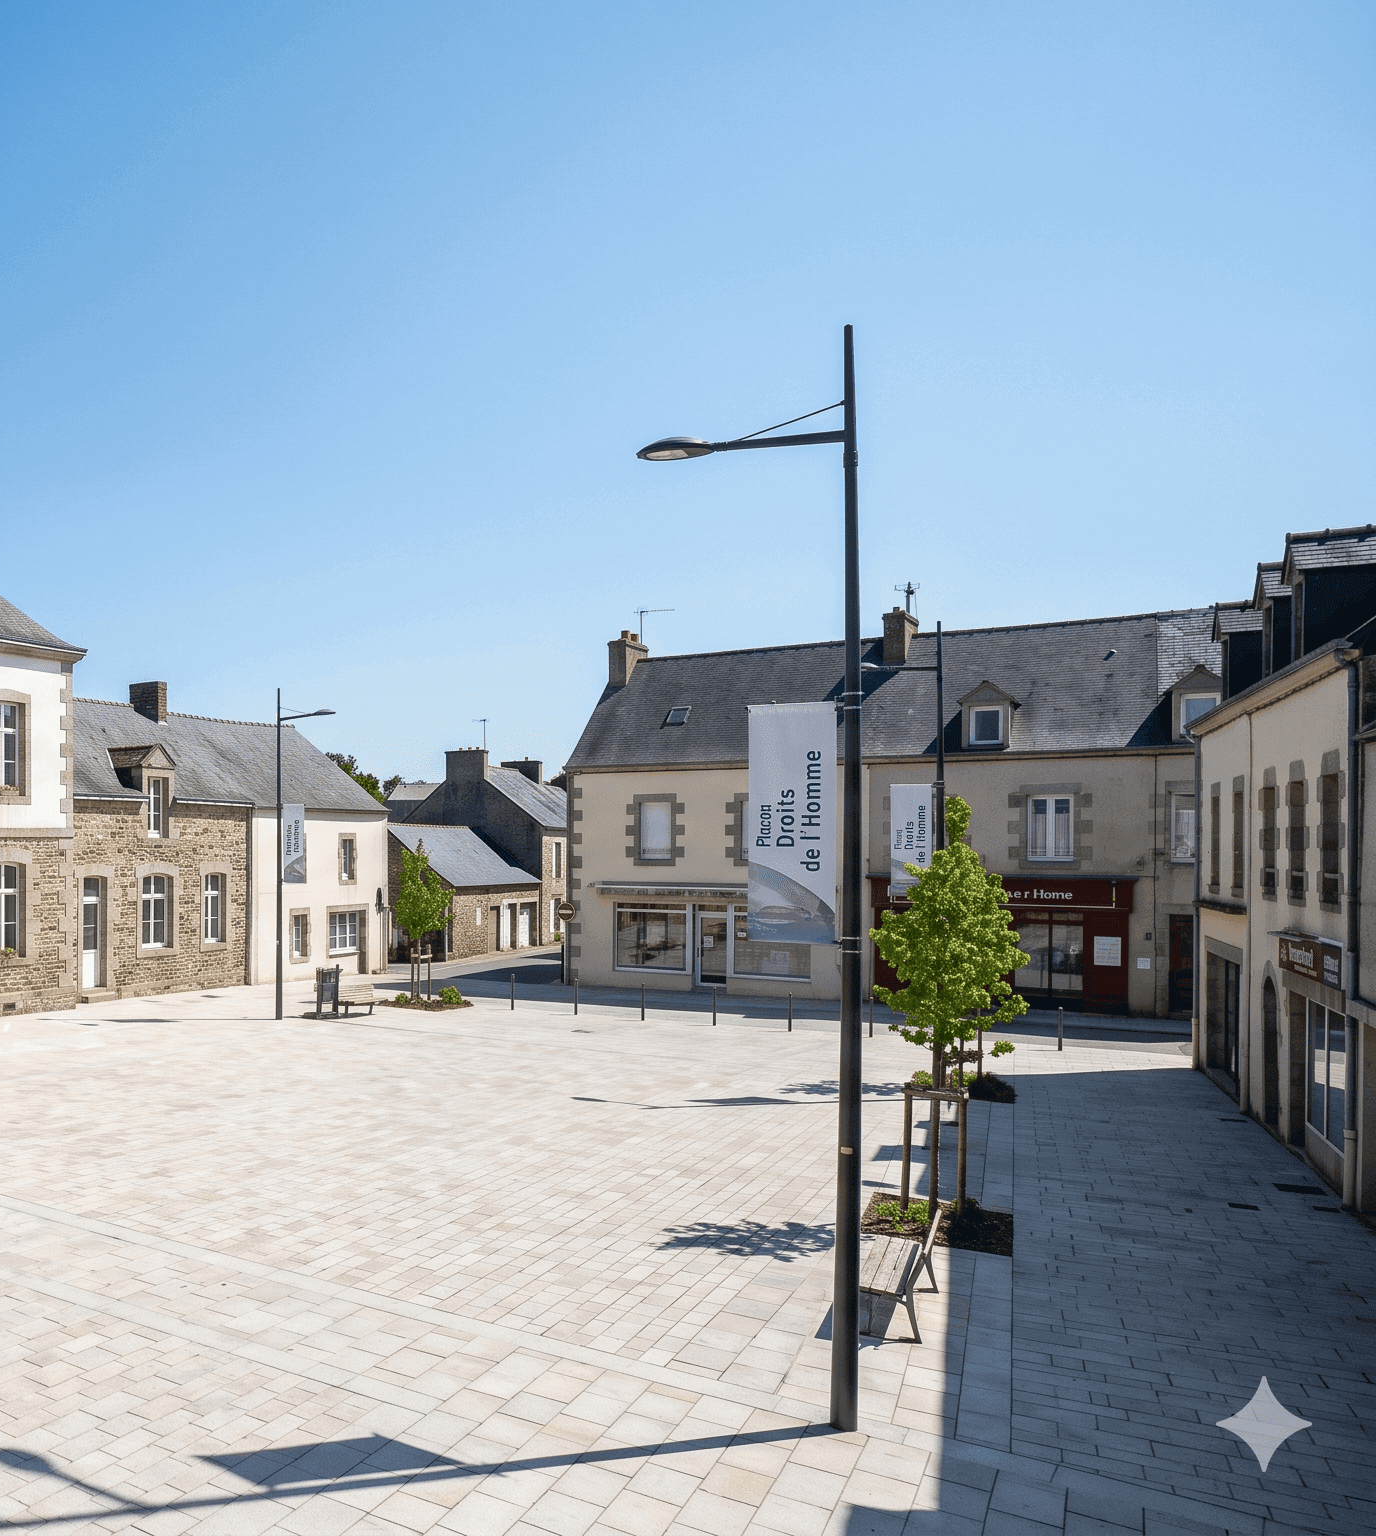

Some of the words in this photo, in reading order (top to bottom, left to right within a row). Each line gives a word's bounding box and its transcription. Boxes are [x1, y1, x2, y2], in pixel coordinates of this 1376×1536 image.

[799, 750, 822, 841] l'Homme
[775, 788, 795, 848] Droits
[799, 848, 821, 872] de
[1033, 888, 1073, 900] Home
